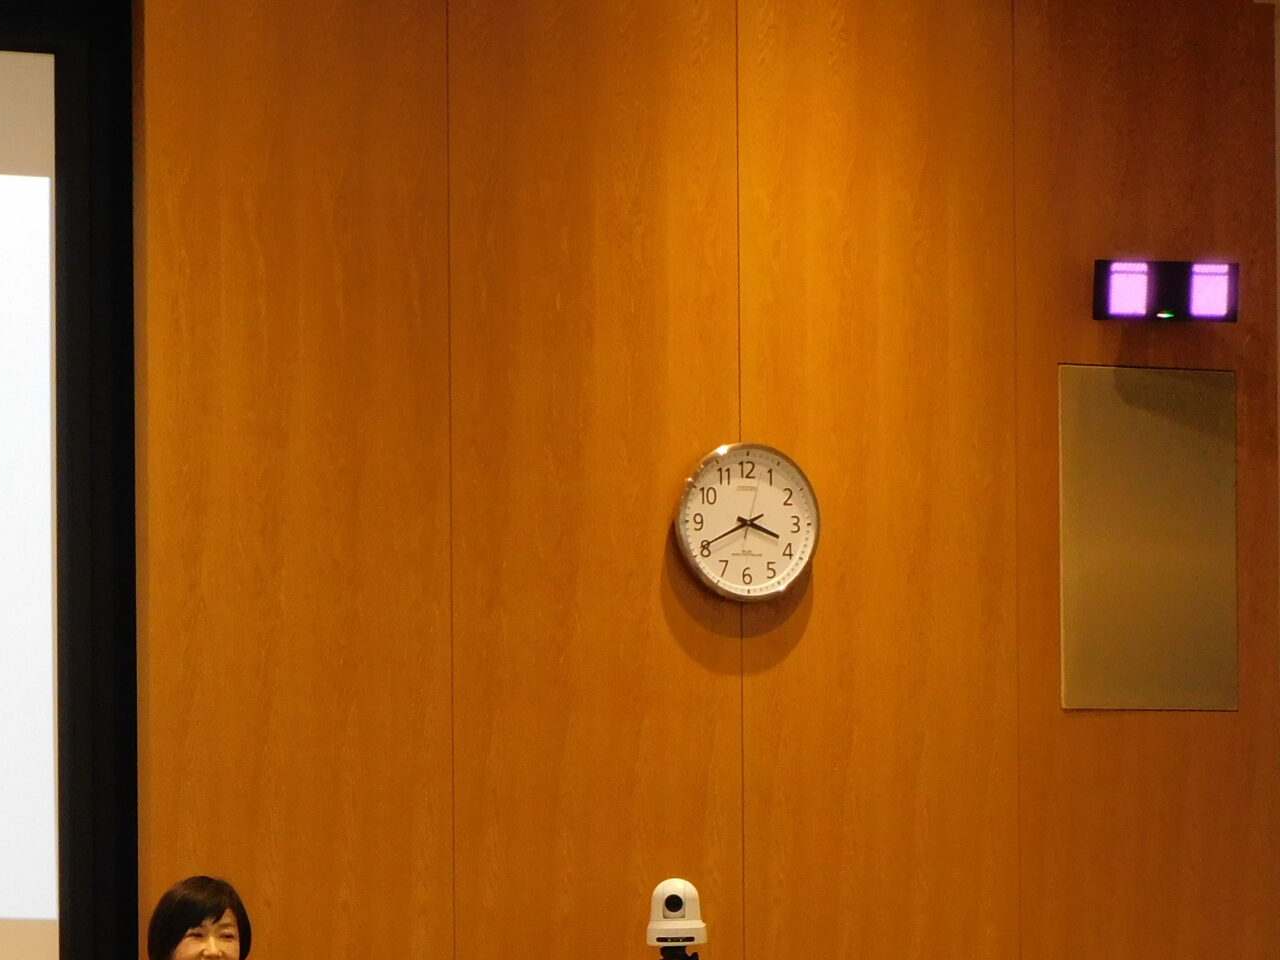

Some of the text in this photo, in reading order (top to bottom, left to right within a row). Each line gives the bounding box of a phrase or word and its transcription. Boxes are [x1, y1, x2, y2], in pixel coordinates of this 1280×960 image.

[717, 467, 731, 485] 11
[738, 461, 756, 479] 12
[767, 468, 773, 487] 1
[699, 487, 717, 505] 10
[782, 488, 793, 506] 2
[693, 513, 704, 531] 9
[790, 515, 801, 534] 3
[700, 539, 711, 558] 8
[782, 542, 793, 560] 4
[719, 560, 729, 577] 7
[742, 567, 753, 585] 6
[766, 561, 777, 579] 5
